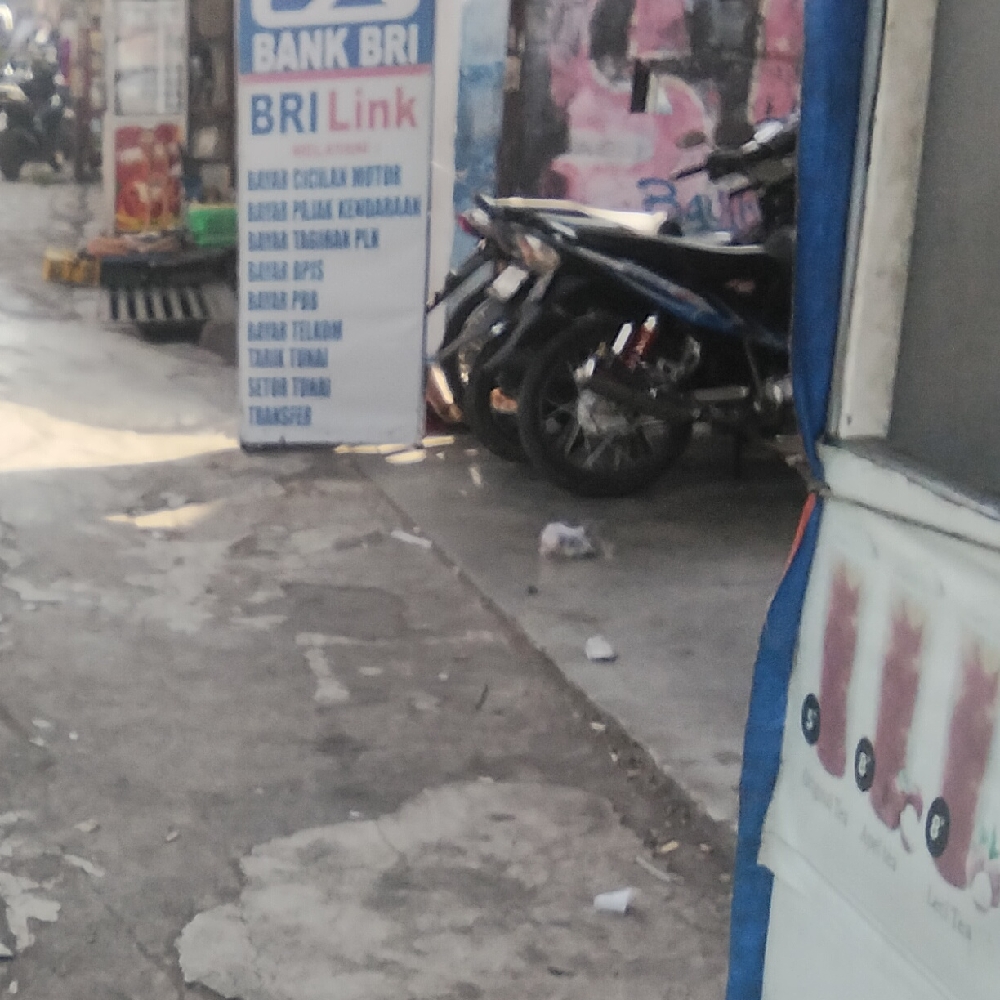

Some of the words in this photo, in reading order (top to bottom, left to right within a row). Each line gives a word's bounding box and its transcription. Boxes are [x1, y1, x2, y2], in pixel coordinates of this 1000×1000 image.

[252, 27, 350, 74] BANK
[358, 24, 418, 67] BRI
[251, 91, 317, 136] BRI
[328, 87, 418, 133] Link
[247, 169, 288, 191] BAYAR
[293, 167, 347, 190] CICILAN
[352, 164, 402, 188] MOTOR
[247, 201, 288, 222] BAYAR
[293, 199, 333, 222] PAJAK
[338, 195, 422, 219] KENDARAAN
[247, 231, 288, 252] BAYAR
[354, 227, 379, 249] PLN
[247, 260, 288, 282] BAYAR
[247, 291, 288, 311] BAYAR
[247, 320, 288, 342] BAYAR
[292, 318, 343, 341] TELKOM
[247, 348, 284, 368] TARIK
[290, 347, 329, 368] TUNAI
[247, 376, 288, 398] SETOR
[292, 376, 331, 398] TUNAI
[247, 405, 312, 427] TRANSFER
